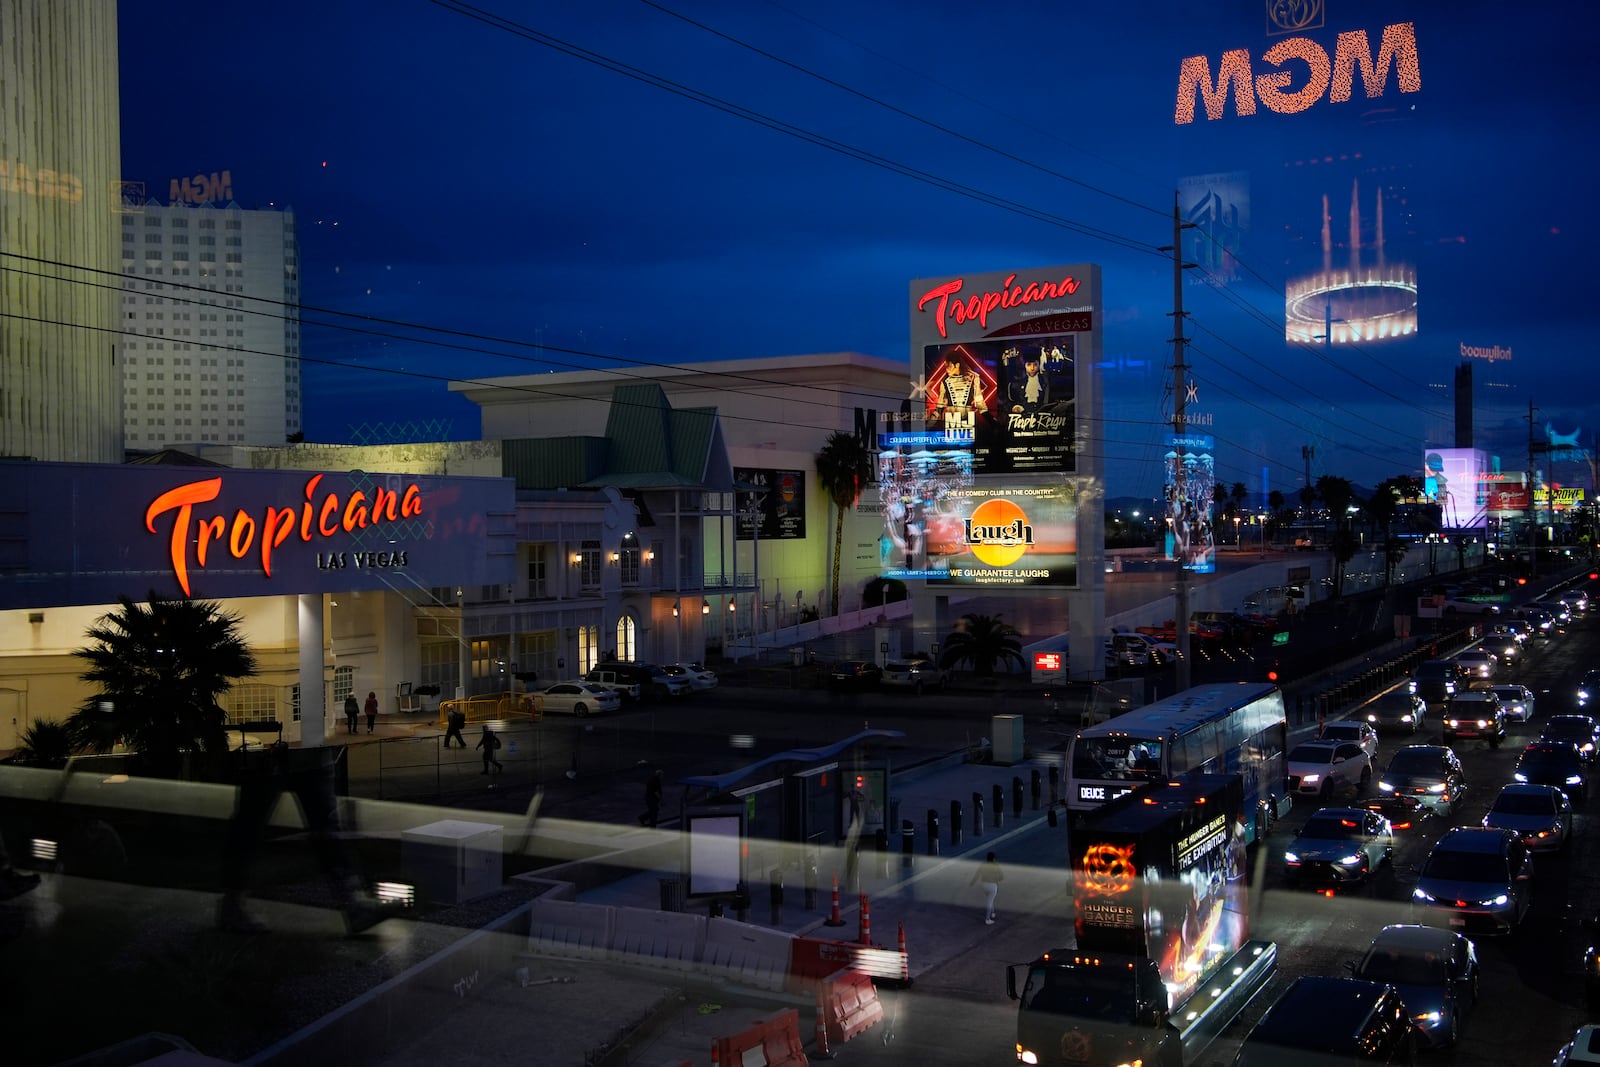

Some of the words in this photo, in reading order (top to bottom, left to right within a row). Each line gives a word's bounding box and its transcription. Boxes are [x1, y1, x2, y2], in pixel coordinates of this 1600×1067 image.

[918, 273, 1081, 338] Tropicana
[1019, 321, 1041, 333] LAS
[1044, 318, 1089, 331] VEGAS
[944, 411, 976, 429] MJ
[145, 473, 423, 598] Tropicana
[963, 518, 1035, 547] Laugh
[316, 552, 347, 571] LAS
[353, 549, 408, 569] VEGAS
[950, 569, 963, 577] WE
[963, 568, 1014, 578] GUARANTEE
[1014, 569, 1050, 578] LAUGHS
[1081, 787, 1104, 799] DEUCE
[1178, 838, 1188, 851] THE
[1188, 825, 1210, 846] HUNGER
[1209, 813, 1226, 833] GAMES
[1179, 856, 1192, 870] THE
[1192, 829, 1227, 863] EXHIBITION
[1084, 904, 1134, 914] HUNGER
[1084, 911, 1134, 923] GAMES
